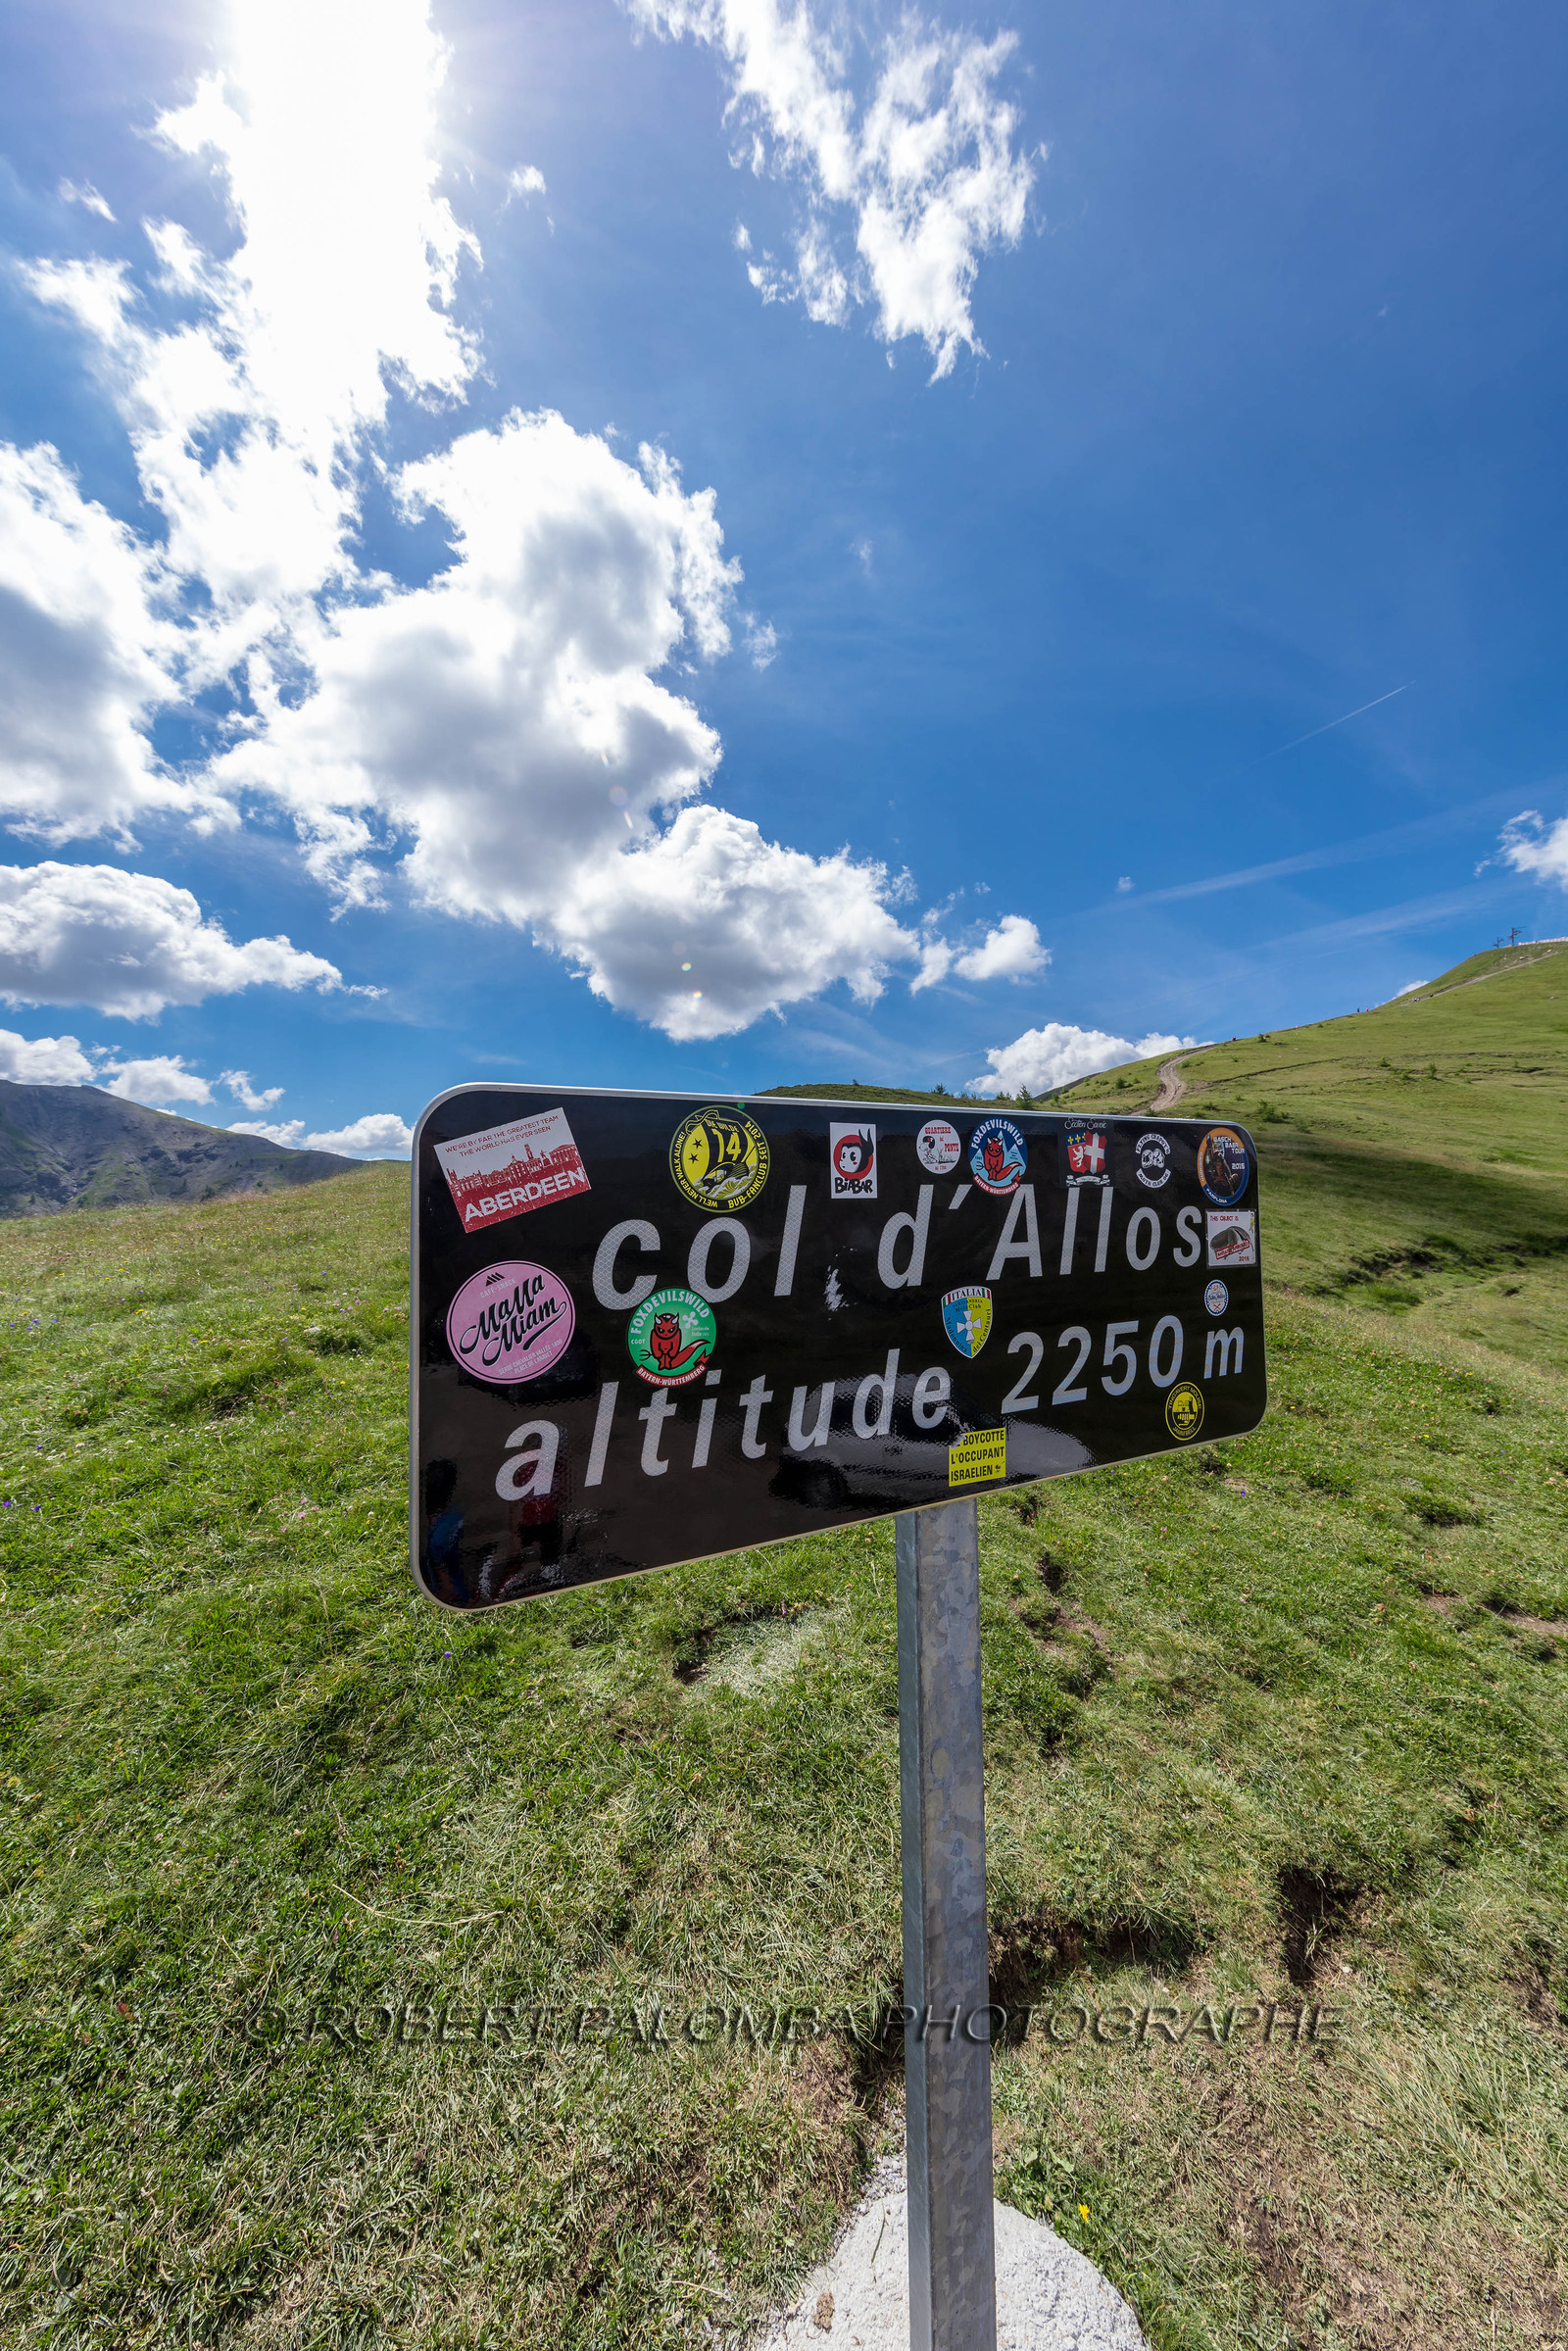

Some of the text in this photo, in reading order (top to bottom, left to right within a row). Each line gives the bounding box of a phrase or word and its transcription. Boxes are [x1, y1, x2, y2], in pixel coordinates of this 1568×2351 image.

[445, 1115, 560, 1154] WE'RE BY FAR THE GREATEST TEAM
[459, 1125, 552, 1158] THE WORLD HAS EVER SEEN
[673, 1131, 687, 1158] ALONE!
[711, 1128, 742, 1163] 14
[970, 1118, 1024, 1150] FOXDEVILSWILD
[673, 1157, 685, 1180] WALK
[727, 1121, 768, 1209] BUB-FANCLUB SEIT 2014
[465, 1166, 586, 1223] ABERDEEN
[680, 1178, 698, 1200] NEVER
[592, 1184, 1202, 1310] col d'Allos
[952, 1288, 982, 1301] ITALIA
[631, 1290, 710, 1335] FOXDEVILSWILD
[980, 1308, 991, 1342] Centauri
[482, 1297, 567, 1367] Miam
[946, 1317, 968, 1353] Madonnina
[512, 1351, 537, 1368] CHEVALIER
[514, 1364, 528, 1374] PLACE
[637, 1364, 706, 1386] BAYERN-WÜRTTEMBERG
[495, 1314, 1245, 1501] altitude 2250 m
[962, 1430, 1004, 1446] BOYCOTTE
[951, 1446, 1004, 1464] L'OCCUPANT
[951, 1464, 993, 1482] ISRAELIEN
